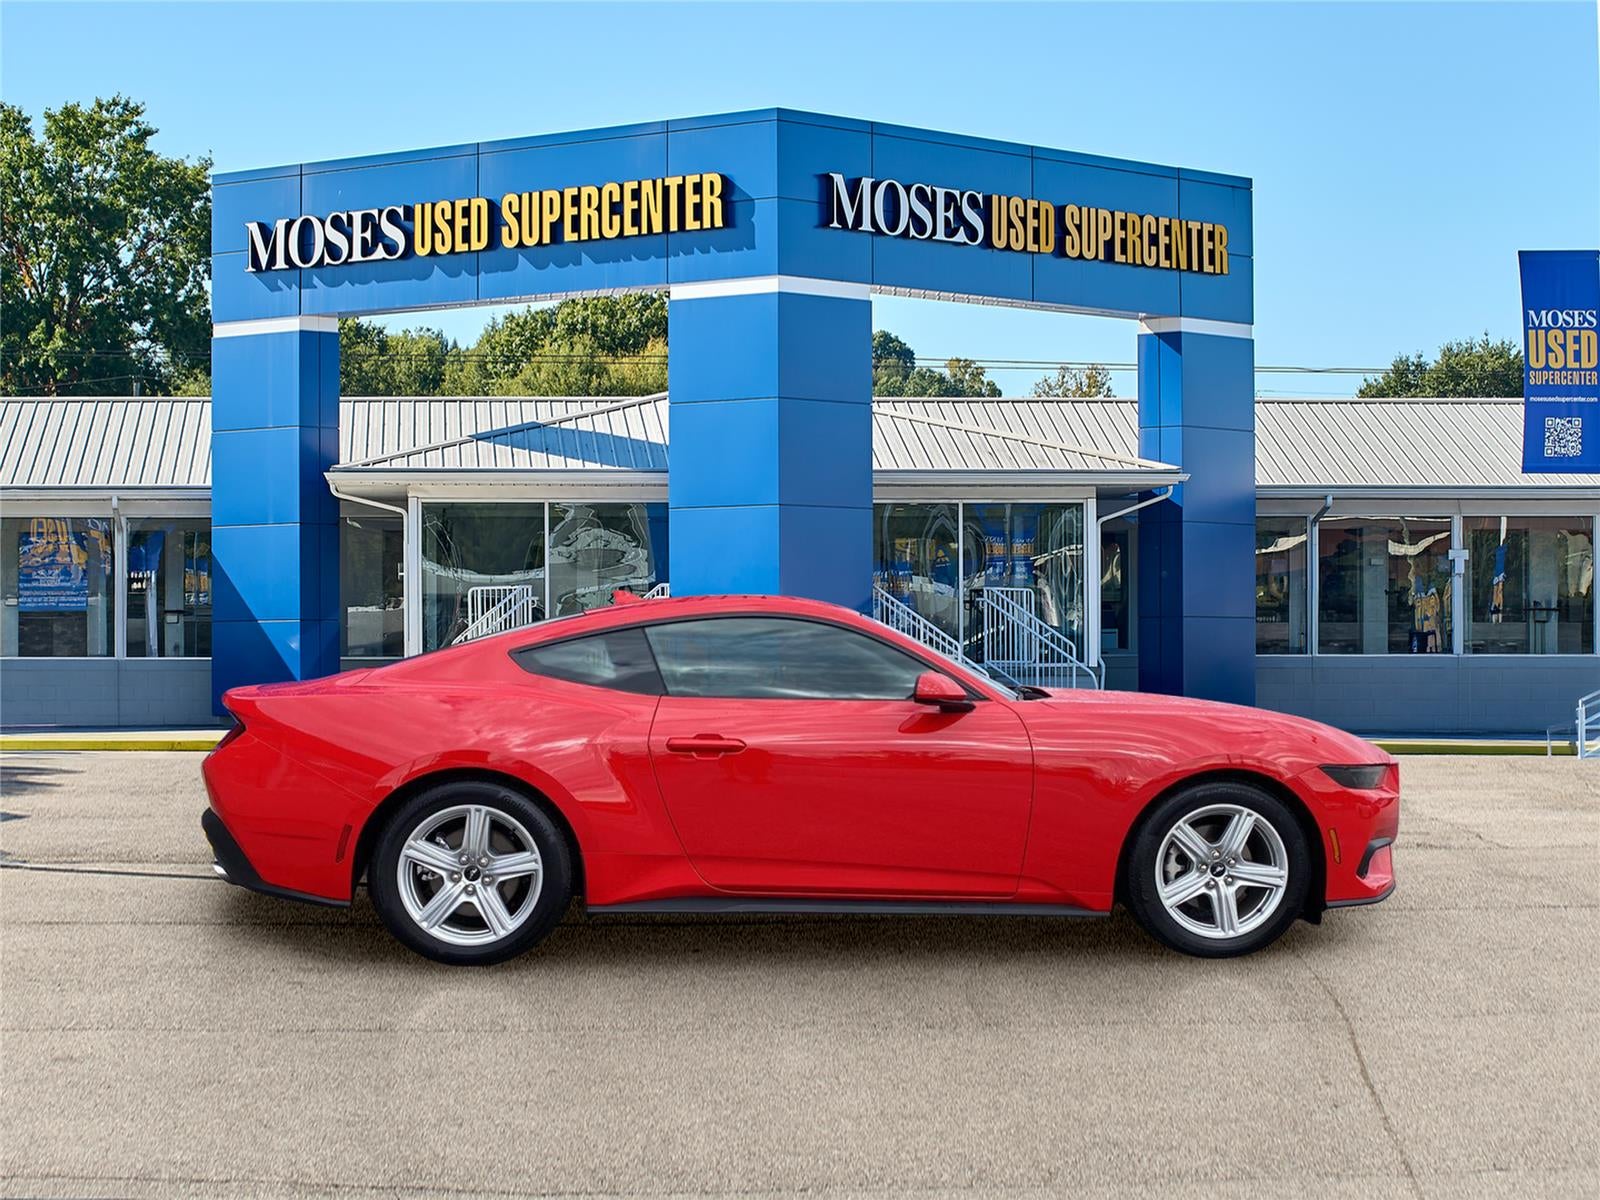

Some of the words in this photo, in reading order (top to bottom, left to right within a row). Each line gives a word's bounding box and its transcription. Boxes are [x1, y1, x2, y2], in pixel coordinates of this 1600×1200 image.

[244, 205, 407, 273] MOSES
[413, 196, 489, 257] USED
[501, 172, 724, 249] SUPERCENTER
[828, 172, 985, 247] MOSES
[991, 193, 1056, 254] USED
[1065, 203, 1230, 275] SUPERCENTER
[1527, 309, 1597, 328] MOSES
[1528, 329, 1598, 369] USED
[1529, 370, 1598, 385] SUPERCENTER
